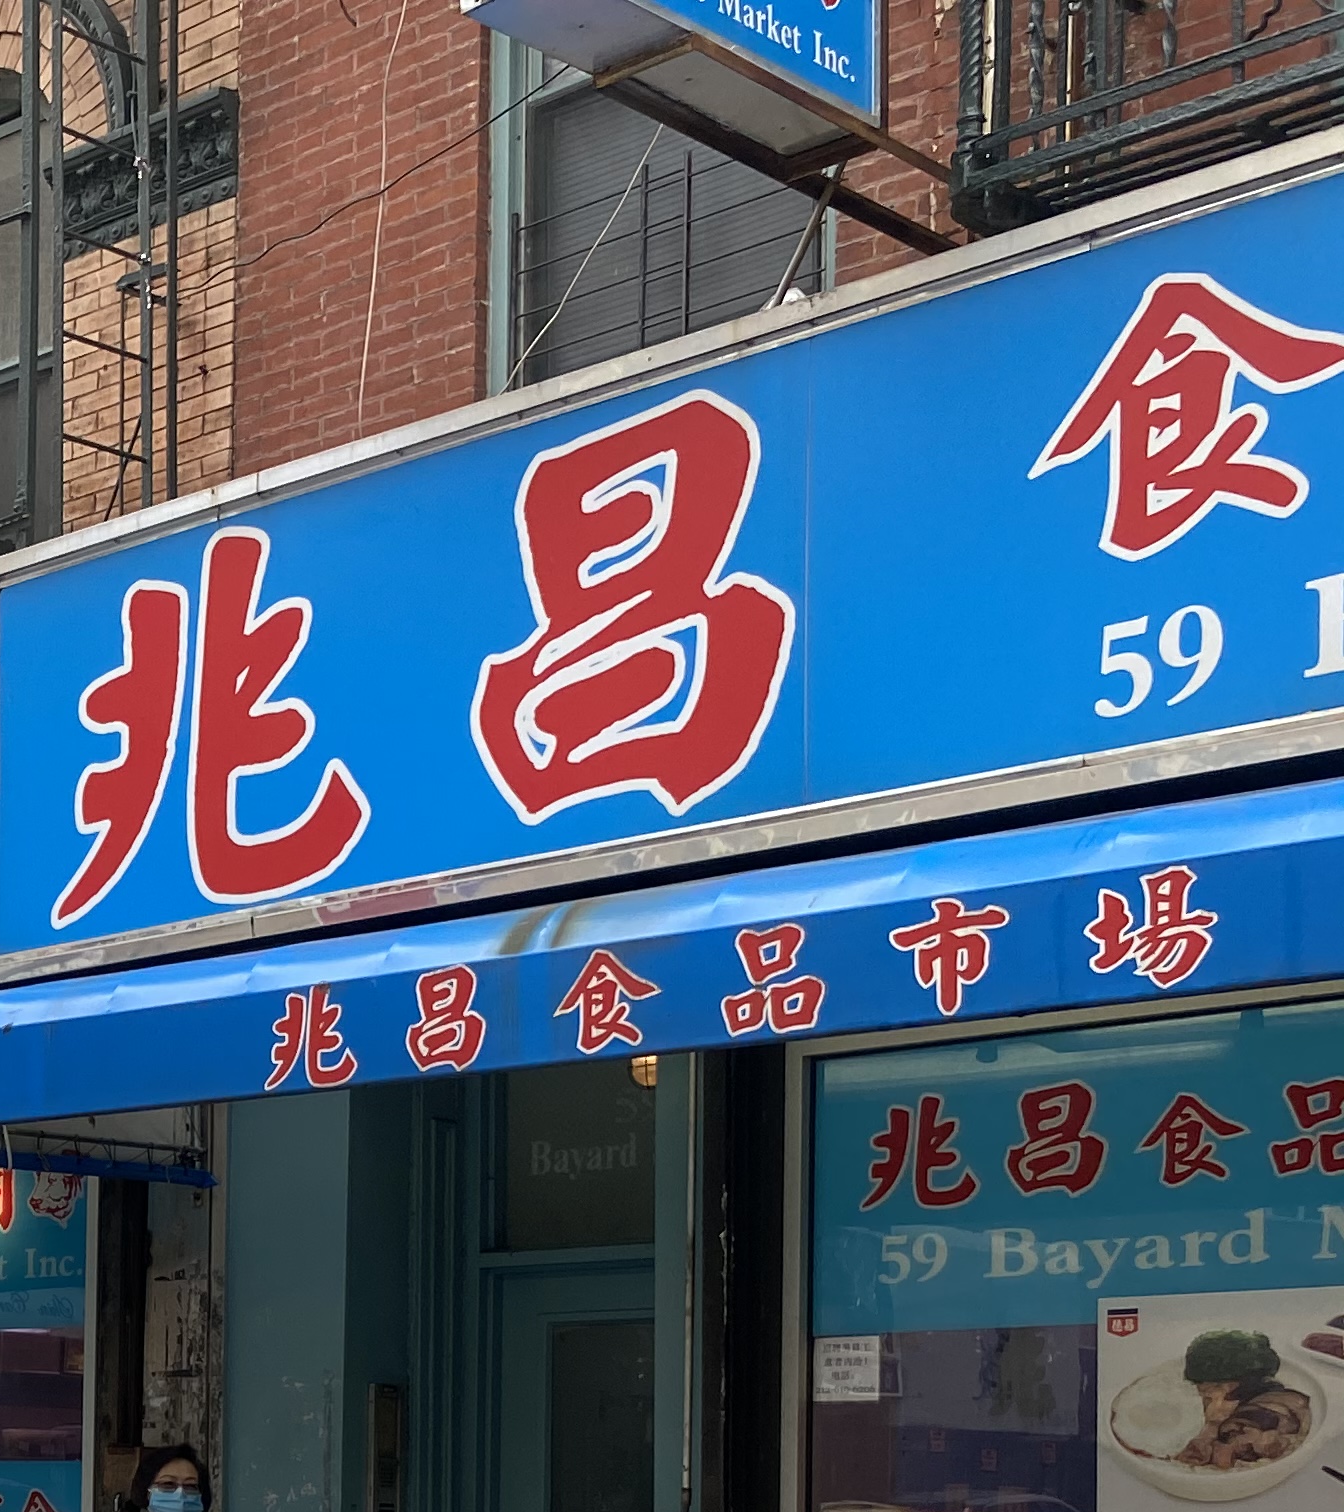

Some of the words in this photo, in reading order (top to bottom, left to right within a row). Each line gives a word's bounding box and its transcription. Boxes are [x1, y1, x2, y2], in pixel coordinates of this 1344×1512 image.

[718, 0, 801, 55] Market
[813, 30, 855, 82] Inc.
[1094, 605, 1223, 718] 59
[264, 863, 1219, 1091] 兆昌食品市場
[531, 1133, 638, 1180] Bayard
[860, 1077, 1344, 1211] 兆昌食品
[23, 1247, 84, 1280] Inc.
[878, 1232, 949, 1286] 59
[984, 1208, 1270, 1289] Bayard
